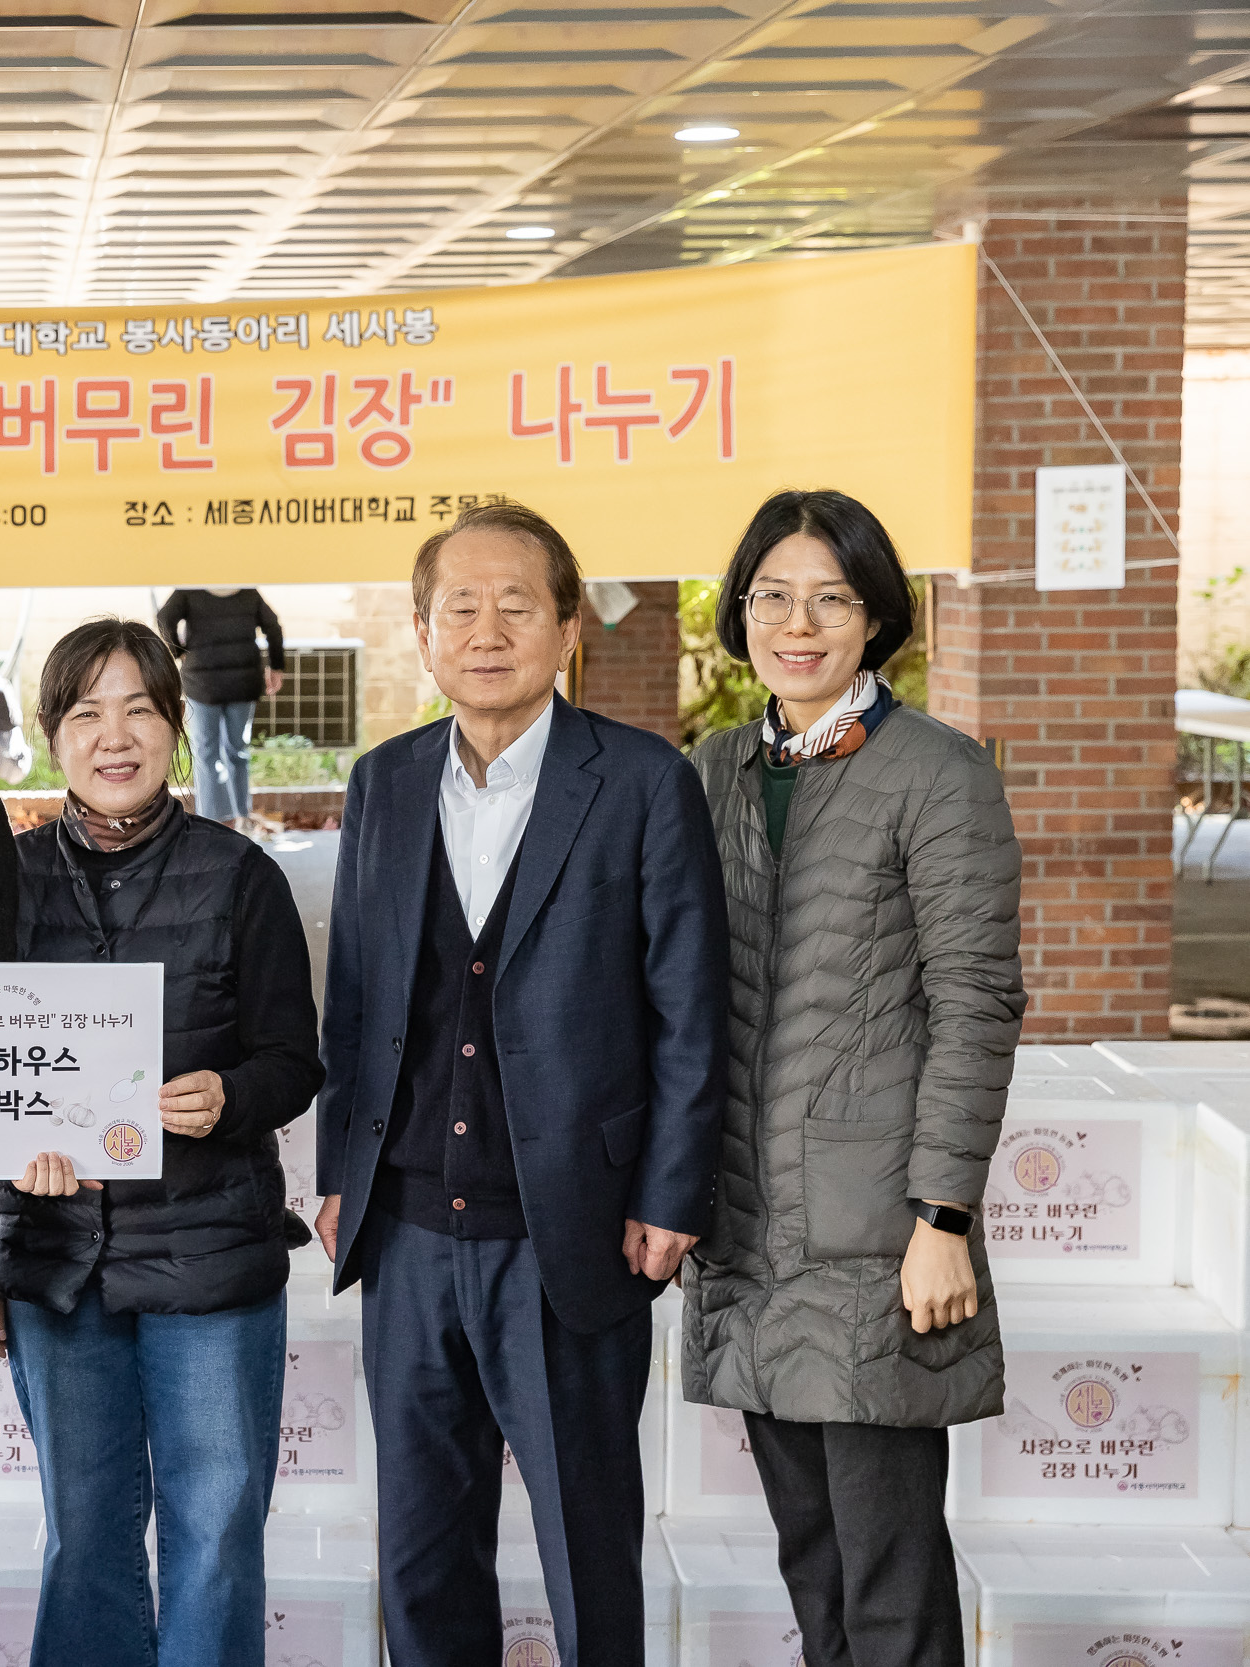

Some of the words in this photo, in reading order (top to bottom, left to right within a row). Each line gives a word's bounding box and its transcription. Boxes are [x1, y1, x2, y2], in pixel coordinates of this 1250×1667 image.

[120, 313, 310, 354] 봉사동아리
[323, 307, 439, 348] 세사봉
[268, 368, 453, 474] 김장"
[508, 355, 739, 466] 나누기
[124, 500, 175, 526] 장소
[204, 496, 418, 525] 세종사이버대학교
[3, 985, 27, 996] 따뜻한
[9, 1013, 56, 1029] 버무린"
[61, 1014, 88, 1029] 김장
[93, 1013, 133, 1028] 나누기
[982, 1202, 1039, 1219] 랑으로
[1047, 1203, 1098, 1220] 버무린
[991, 1225, 1024, 1241] 김장
[1032, 1225, 1083, 1241] 나누기
[280, 1426, 312, 1442] 무린
[1019, 1439, 1092, 1456] 사랑으로
[1100, 1439, 1154, 1456] 버무린
[1041, 1462, 1076, 1479] 김장
[1084, 1462, 1138, 1479] 나누기
